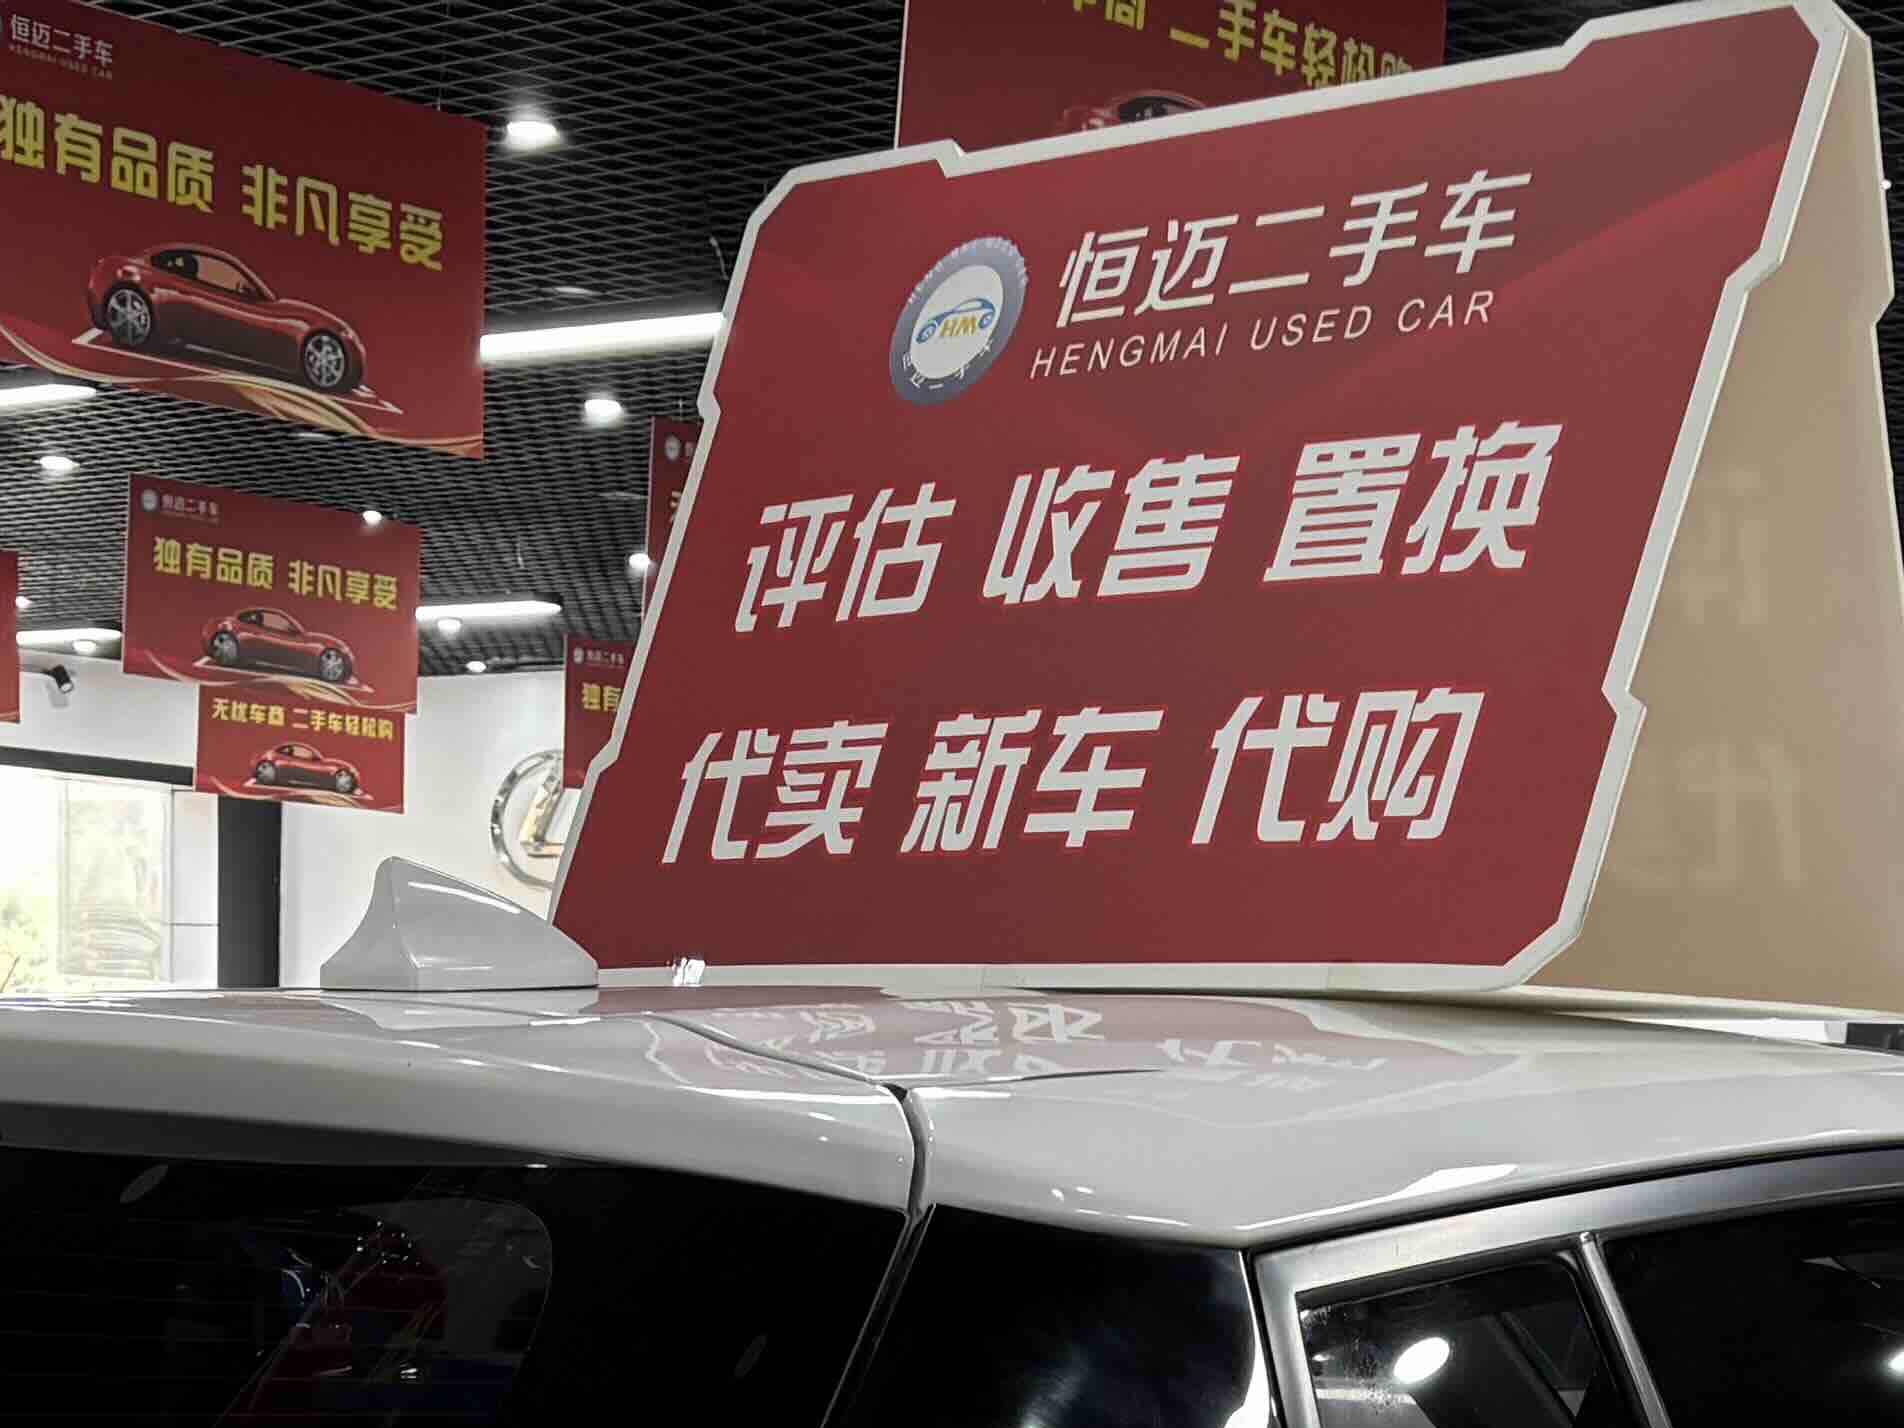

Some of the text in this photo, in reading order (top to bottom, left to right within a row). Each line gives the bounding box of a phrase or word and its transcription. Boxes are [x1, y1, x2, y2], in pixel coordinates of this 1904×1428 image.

[10, 14, 112, 66] 恒迈二手车
[242, 163, 442, 271] 非凡享受
[1056, 169, 1532, 329] 恒迈二手车
[1030, 323, 1227, 380] HENGMAI
[1252, 304, 1373, 351] USED
[1398, 290, 1496, 333] CAR
[153, 536, 399, 611] 独有品质 非凡享受
[735, 420, 1563, 633] 评估 收售 置换
[661, 687, 1484, 865] 代卖 新车 代购
